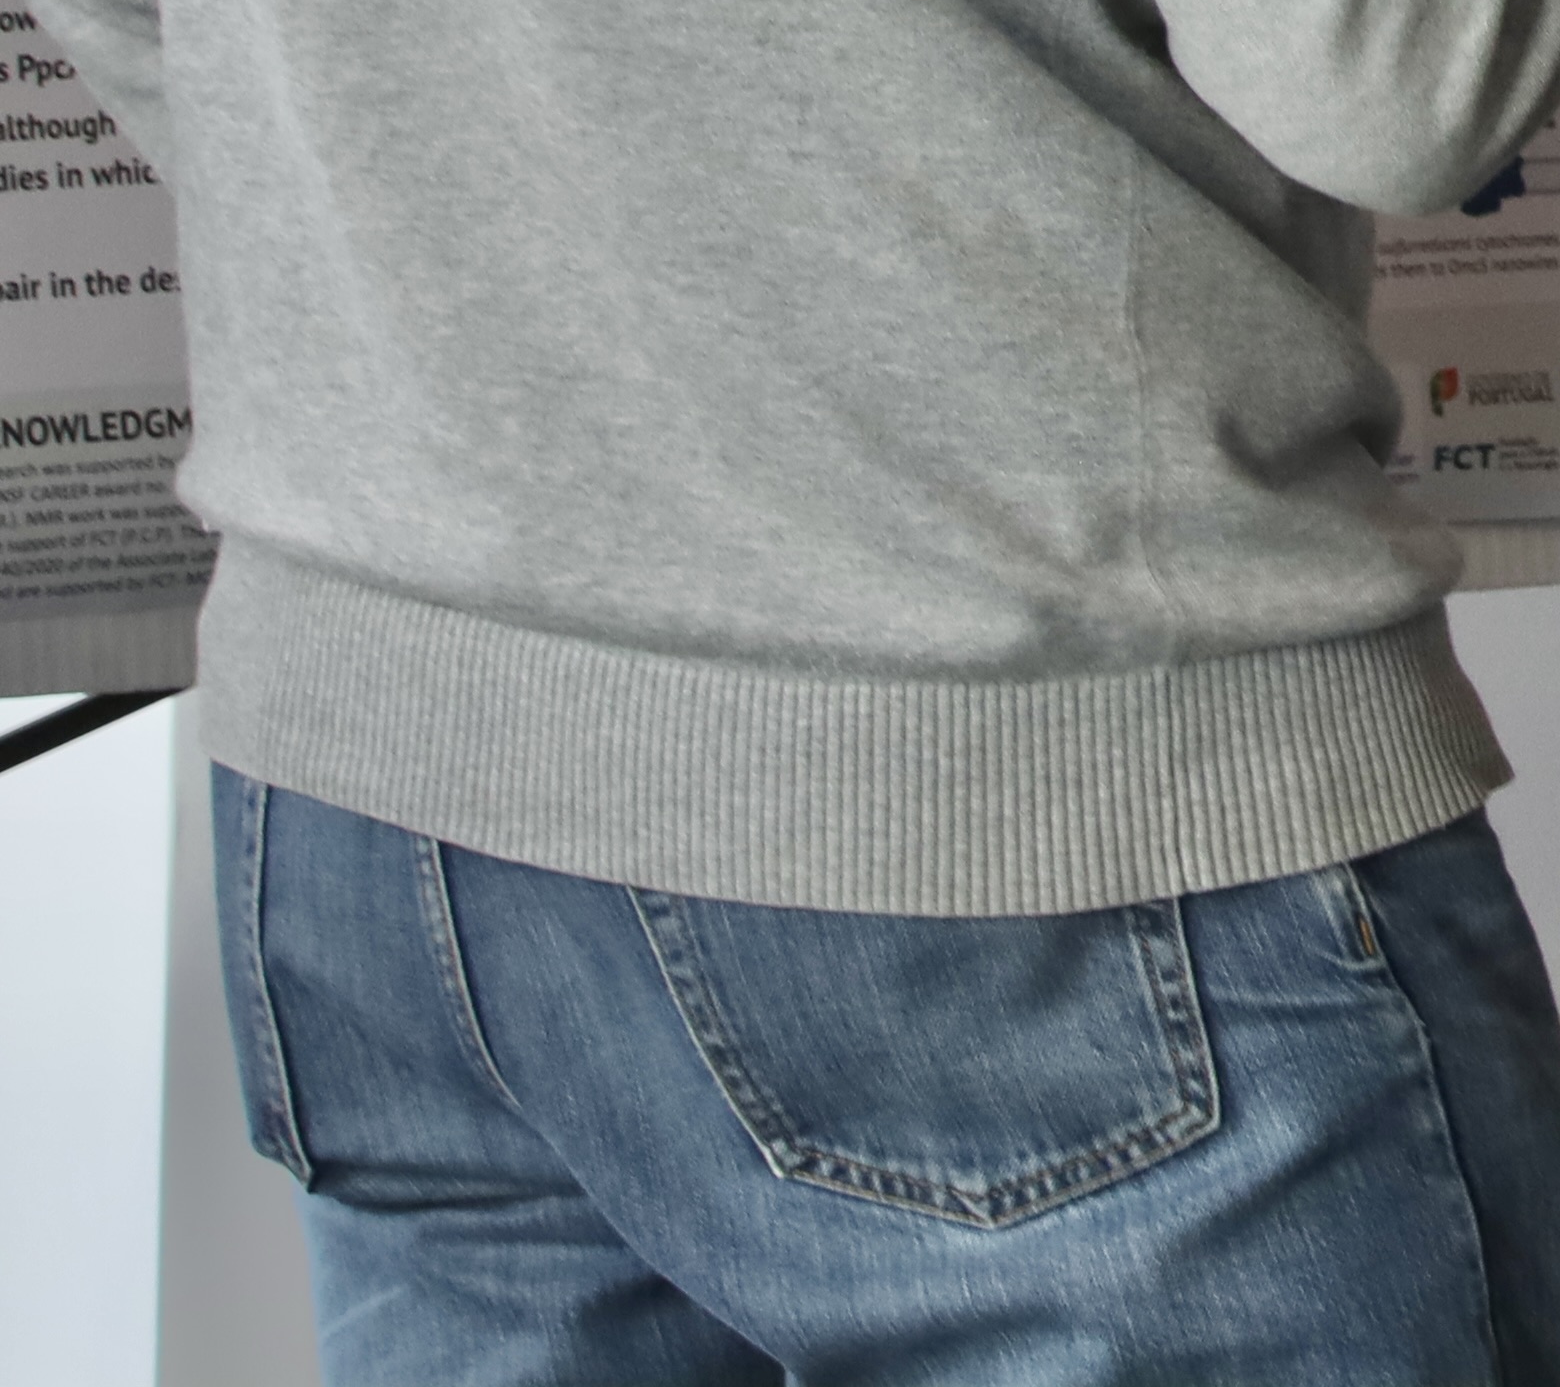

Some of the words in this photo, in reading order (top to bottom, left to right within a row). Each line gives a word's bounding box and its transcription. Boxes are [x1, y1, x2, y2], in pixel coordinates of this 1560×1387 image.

[57, 162, 83, 188] in
[50, 271, 77, 298] in
[84, 269, 131, 297] the
[1434, 442, 1496, 470] FCT
